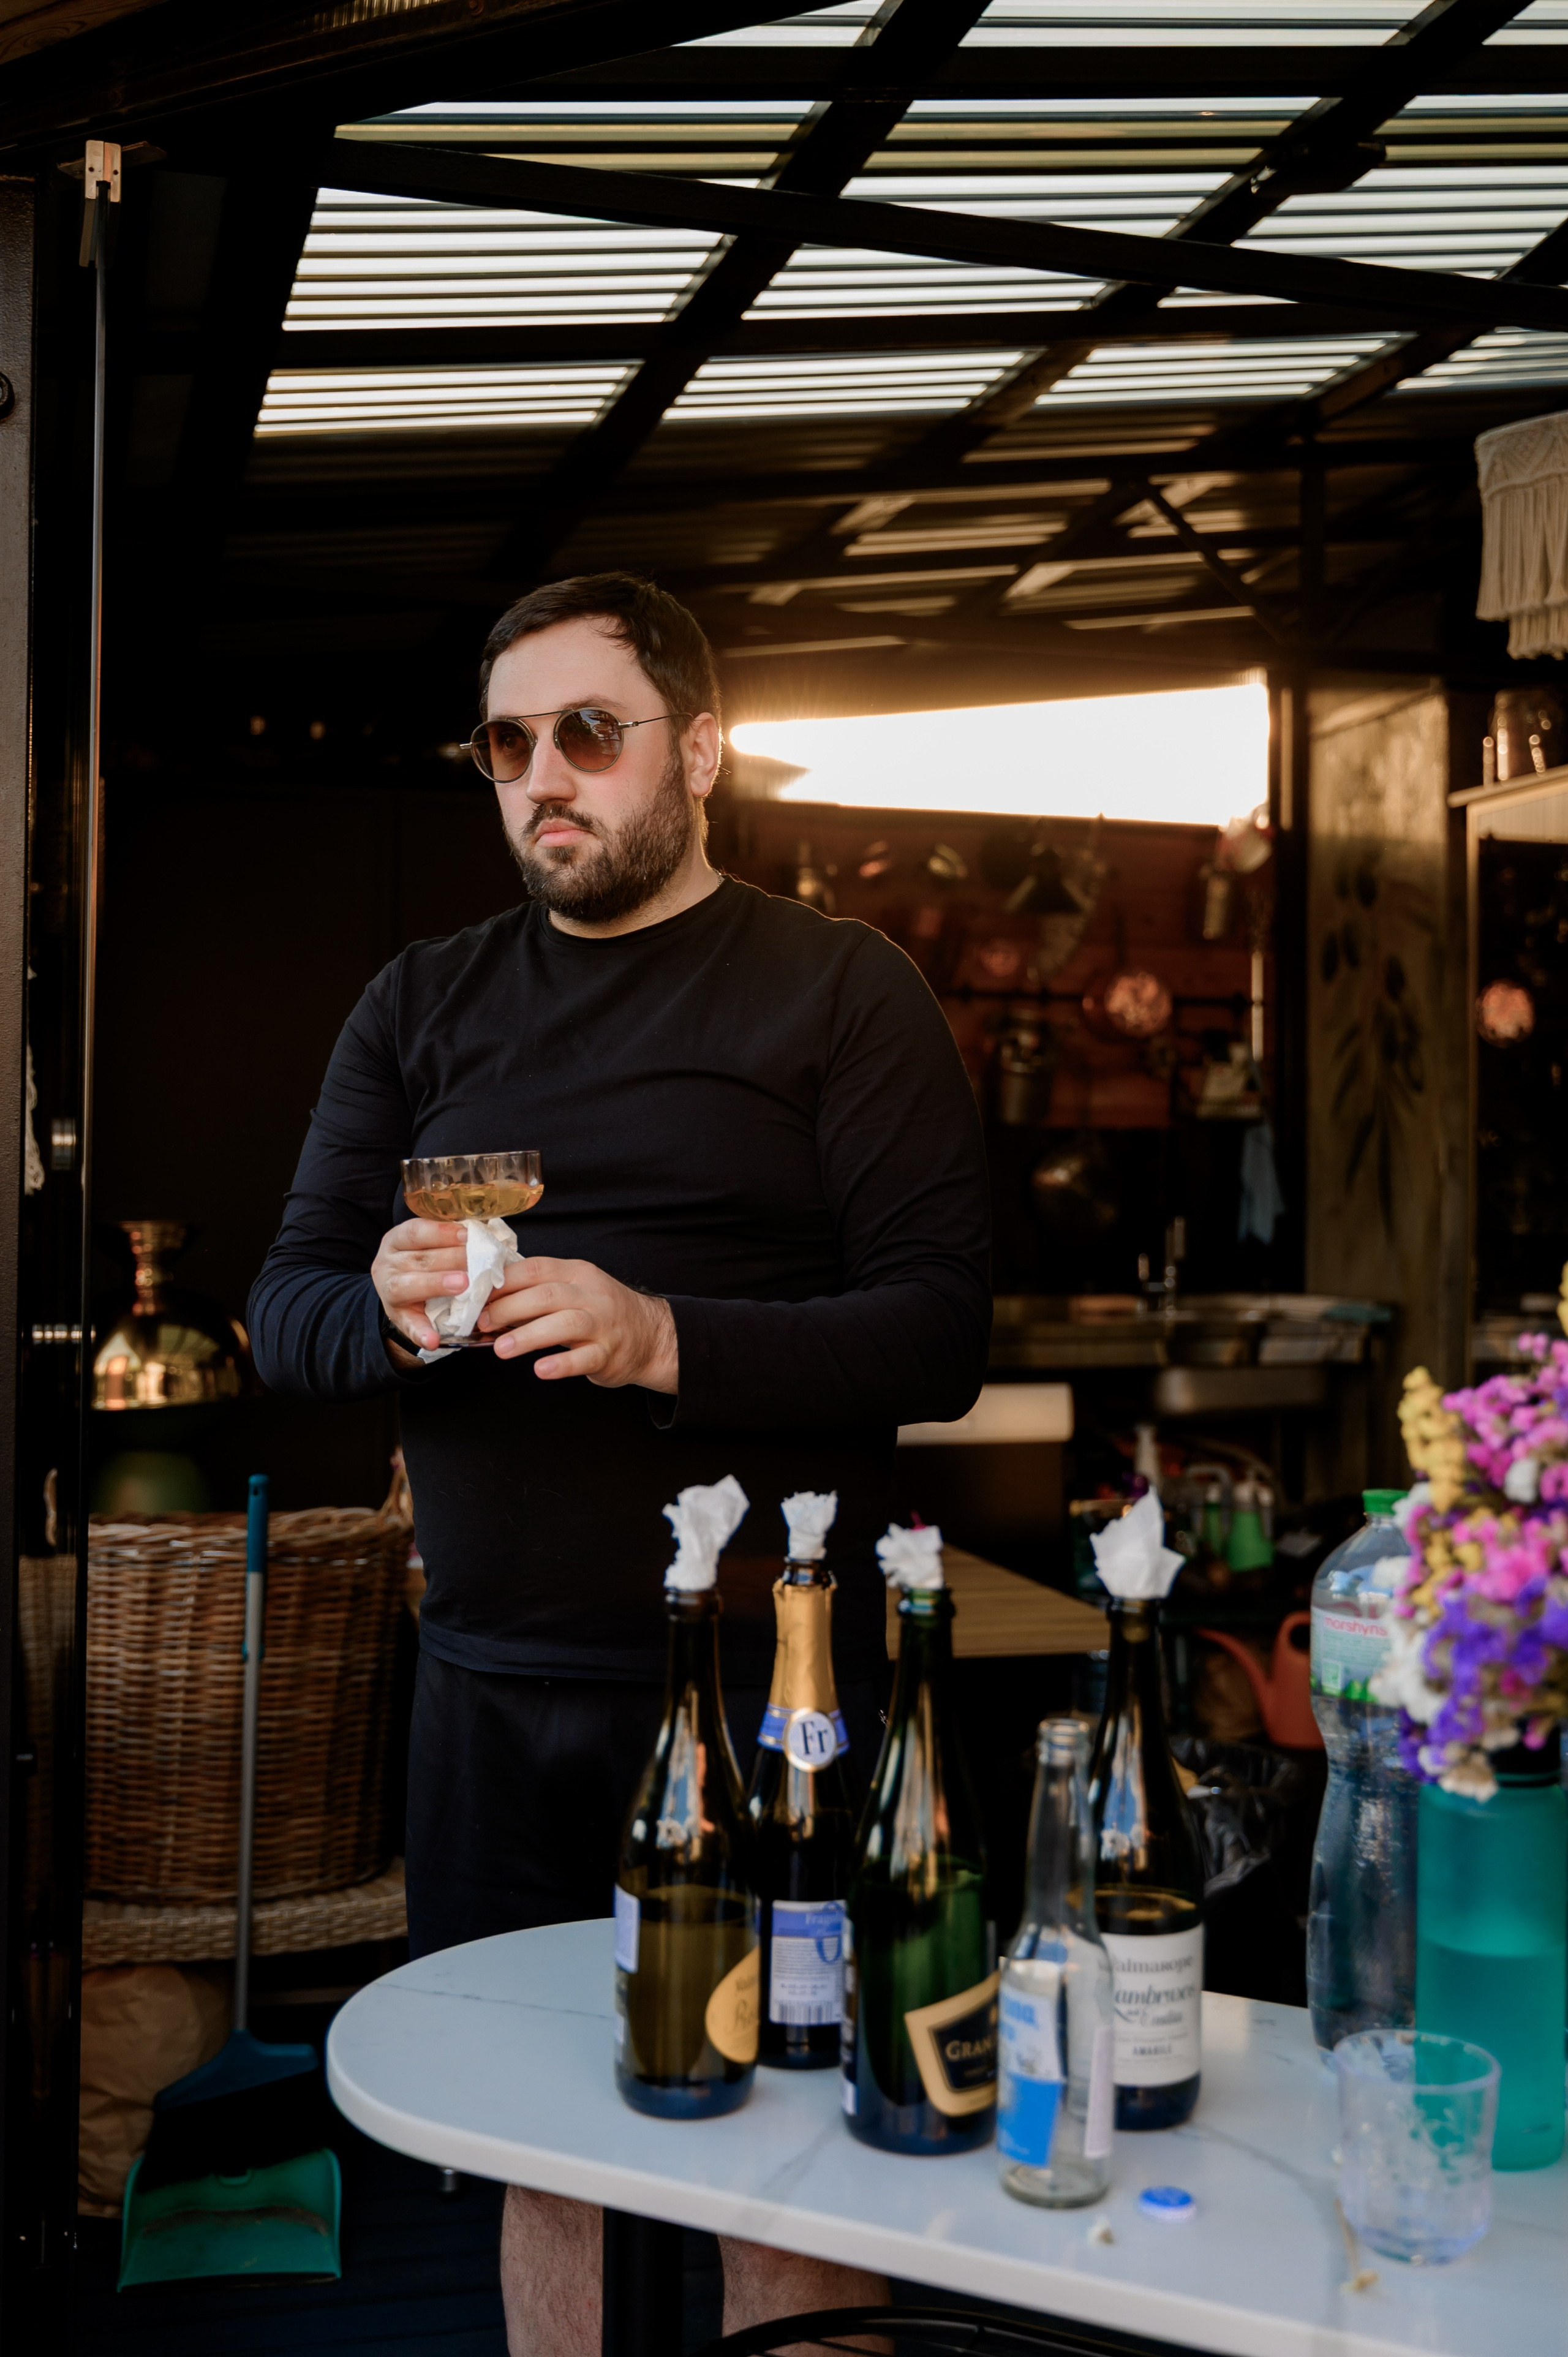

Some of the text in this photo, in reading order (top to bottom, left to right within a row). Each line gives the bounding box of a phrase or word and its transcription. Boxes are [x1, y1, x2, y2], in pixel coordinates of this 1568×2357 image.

[1324, 1617, 1387, 1636] morshyns
[800, 1721, 828, 1755] Fr
[944, 2036, 993, 2062] GRAN
